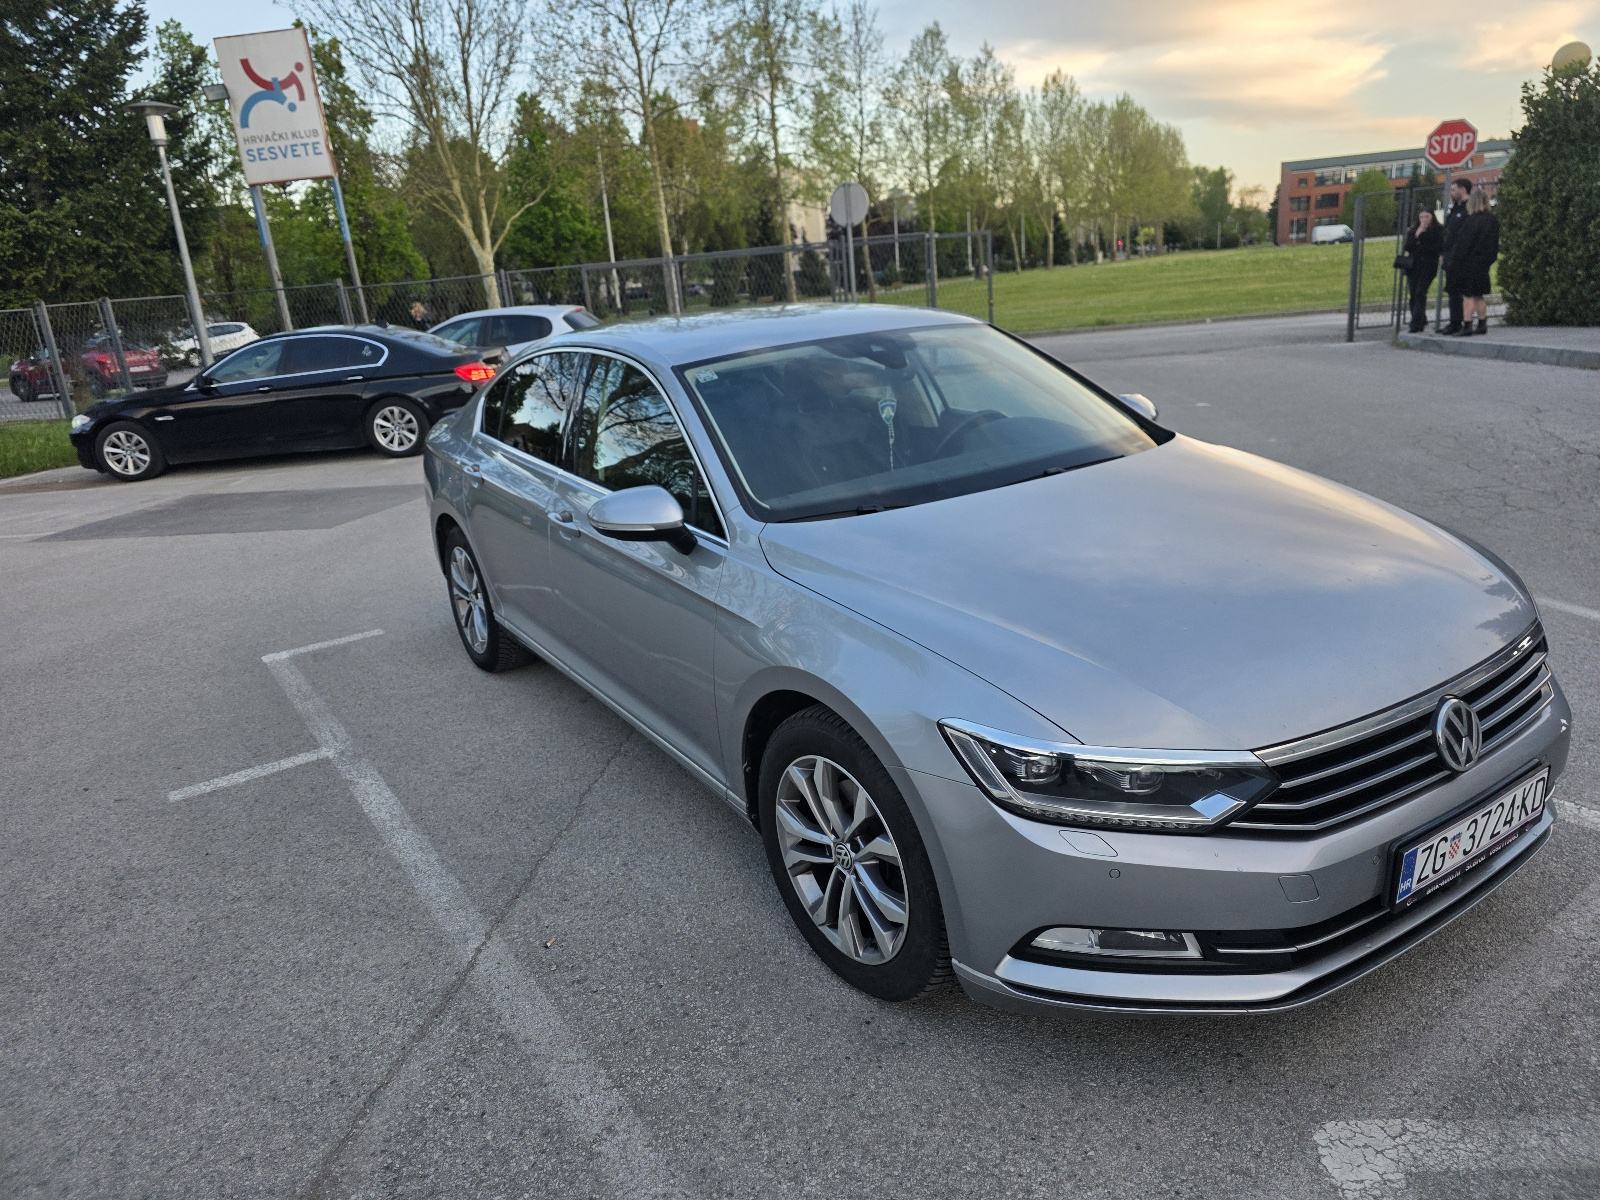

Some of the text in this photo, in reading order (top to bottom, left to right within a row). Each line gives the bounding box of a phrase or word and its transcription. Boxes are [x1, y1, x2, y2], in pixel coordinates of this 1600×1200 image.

[243, 128, 320, 145] HRVAČKI KLUB
[1429, 132, 1474, 155] STOP
[245, 141, 323, 162] SESVETE
[1416, 836, 1449, 885] ZG
[1400, 877, 1413, 894] HR
